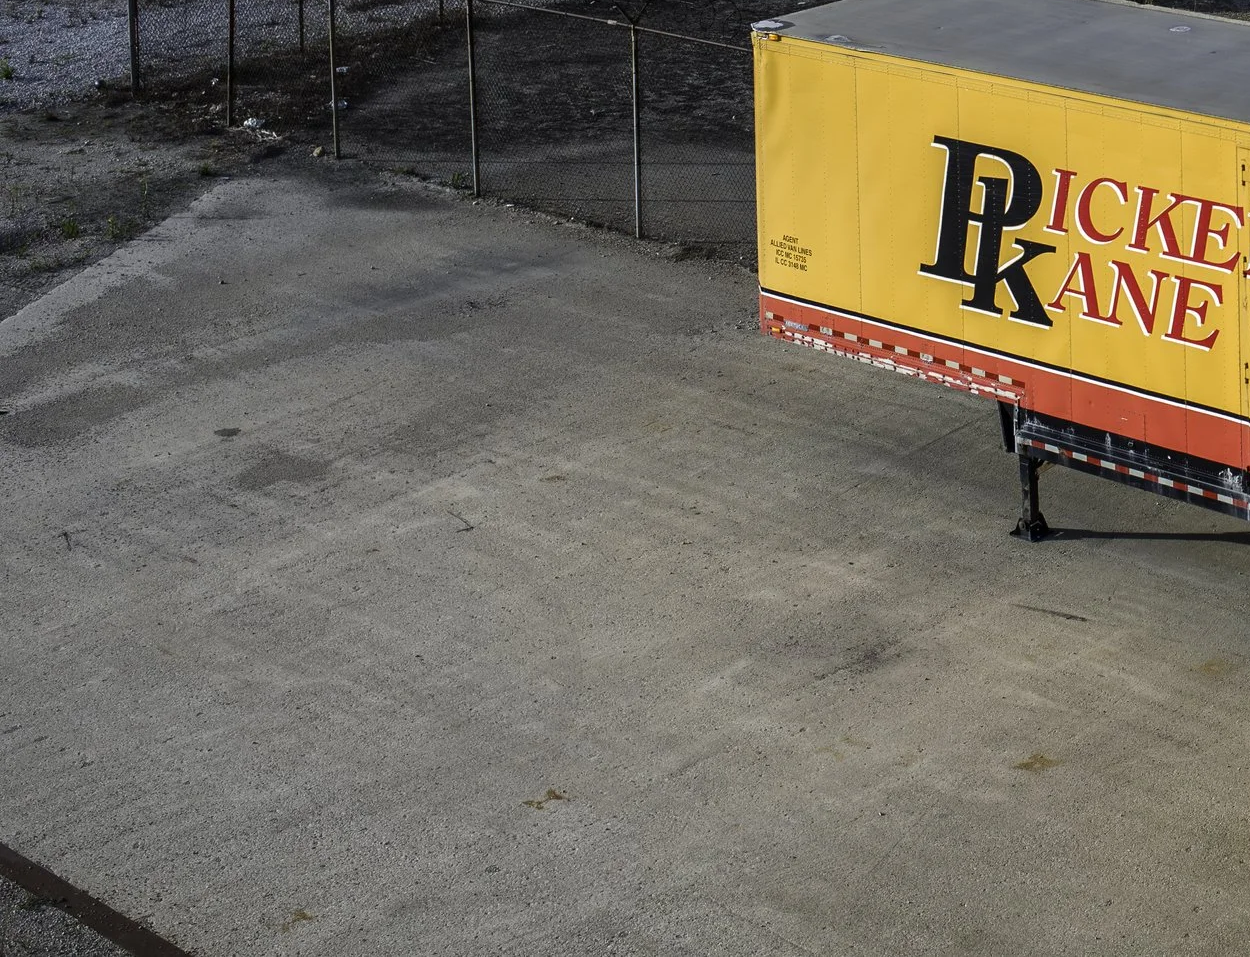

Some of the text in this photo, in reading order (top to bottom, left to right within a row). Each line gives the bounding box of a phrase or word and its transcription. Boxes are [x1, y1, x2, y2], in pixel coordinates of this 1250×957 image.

[783, 234, 799, 244] AGENT
[770, 239, 787, 250] ALLIED
[797, 246, 812, 256] LINES
